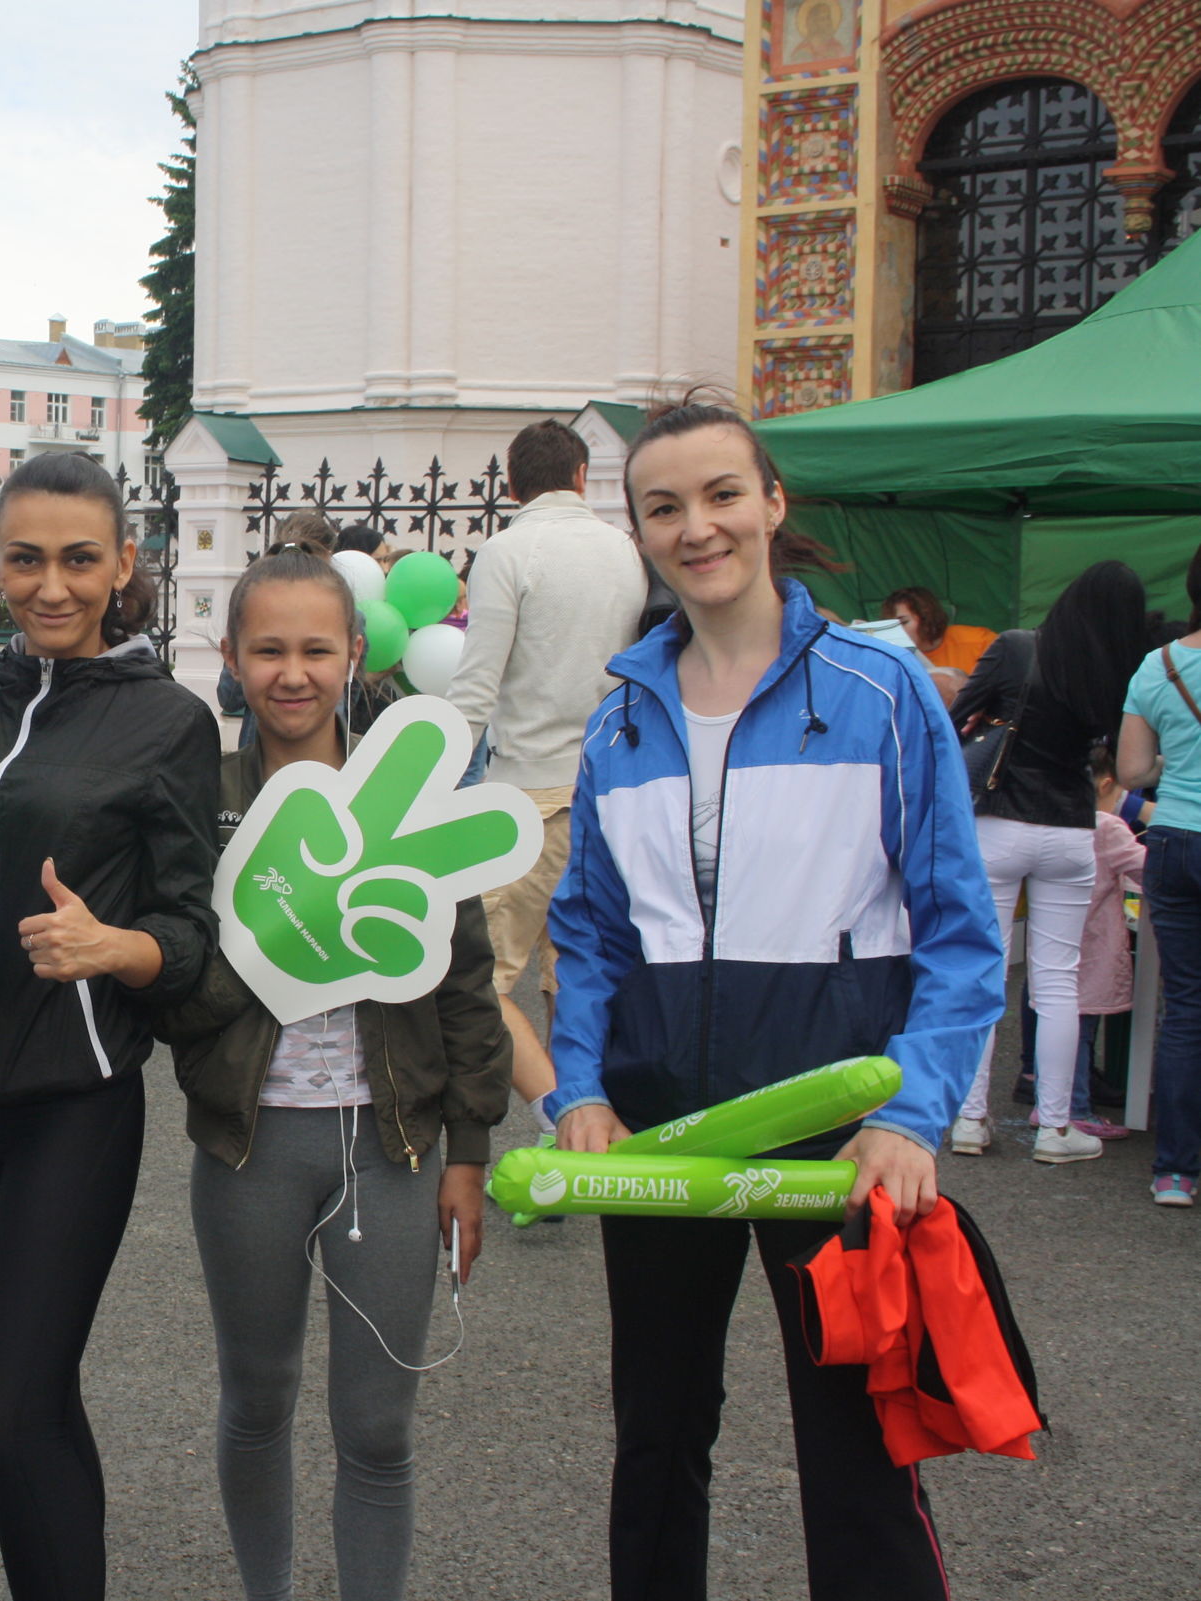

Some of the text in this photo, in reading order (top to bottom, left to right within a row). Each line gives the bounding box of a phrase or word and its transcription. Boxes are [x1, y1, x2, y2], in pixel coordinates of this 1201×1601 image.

[277, 896, 330, 961] ЗЕЛЕНЫЙ МАРАФОН
[572, 1174, 691, 1201] СБЕРБАНК
[774, 1191, 836, 1208] ЗЕЛЕНЫЙ
